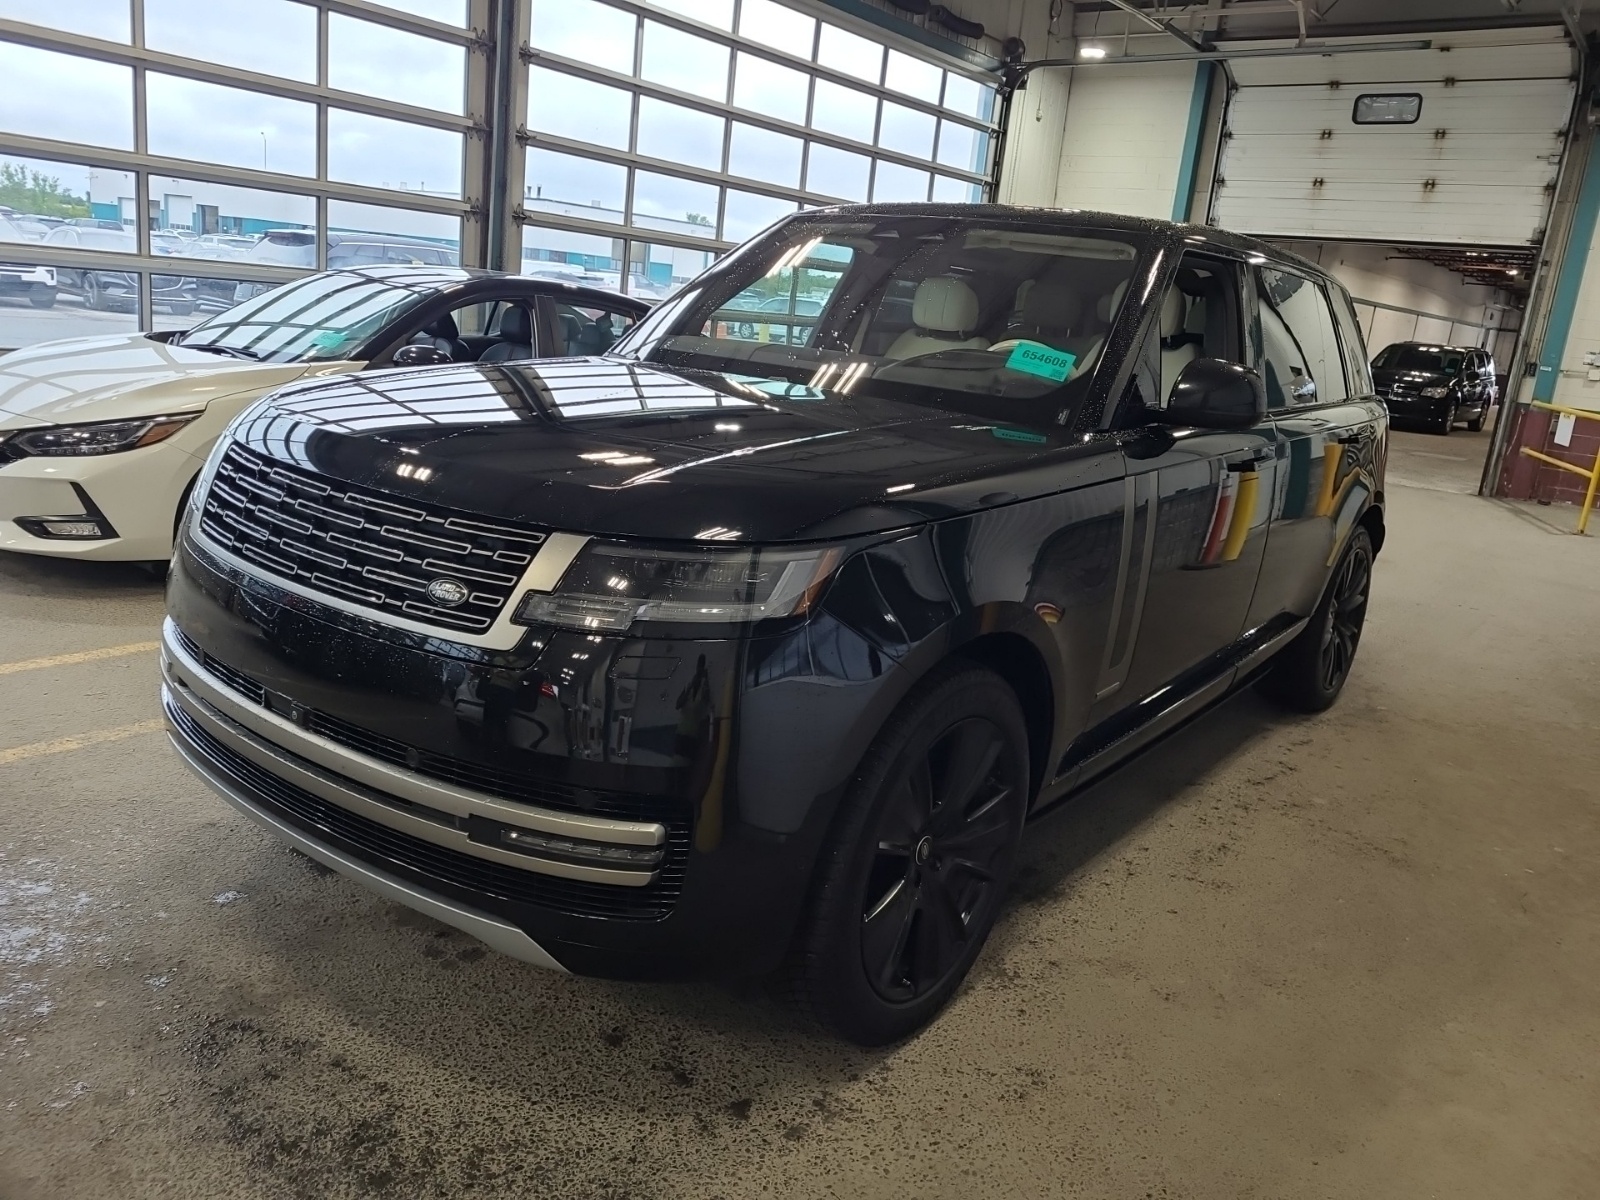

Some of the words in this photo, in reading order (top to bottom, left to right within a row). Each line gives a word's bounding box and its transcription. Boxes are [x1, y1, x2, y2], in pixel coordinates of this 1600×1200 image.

[1022, 350, 1068, 368] 654608
[435, 582, 457, 592] LAND
[434, 590, 461, 601] ROVER
